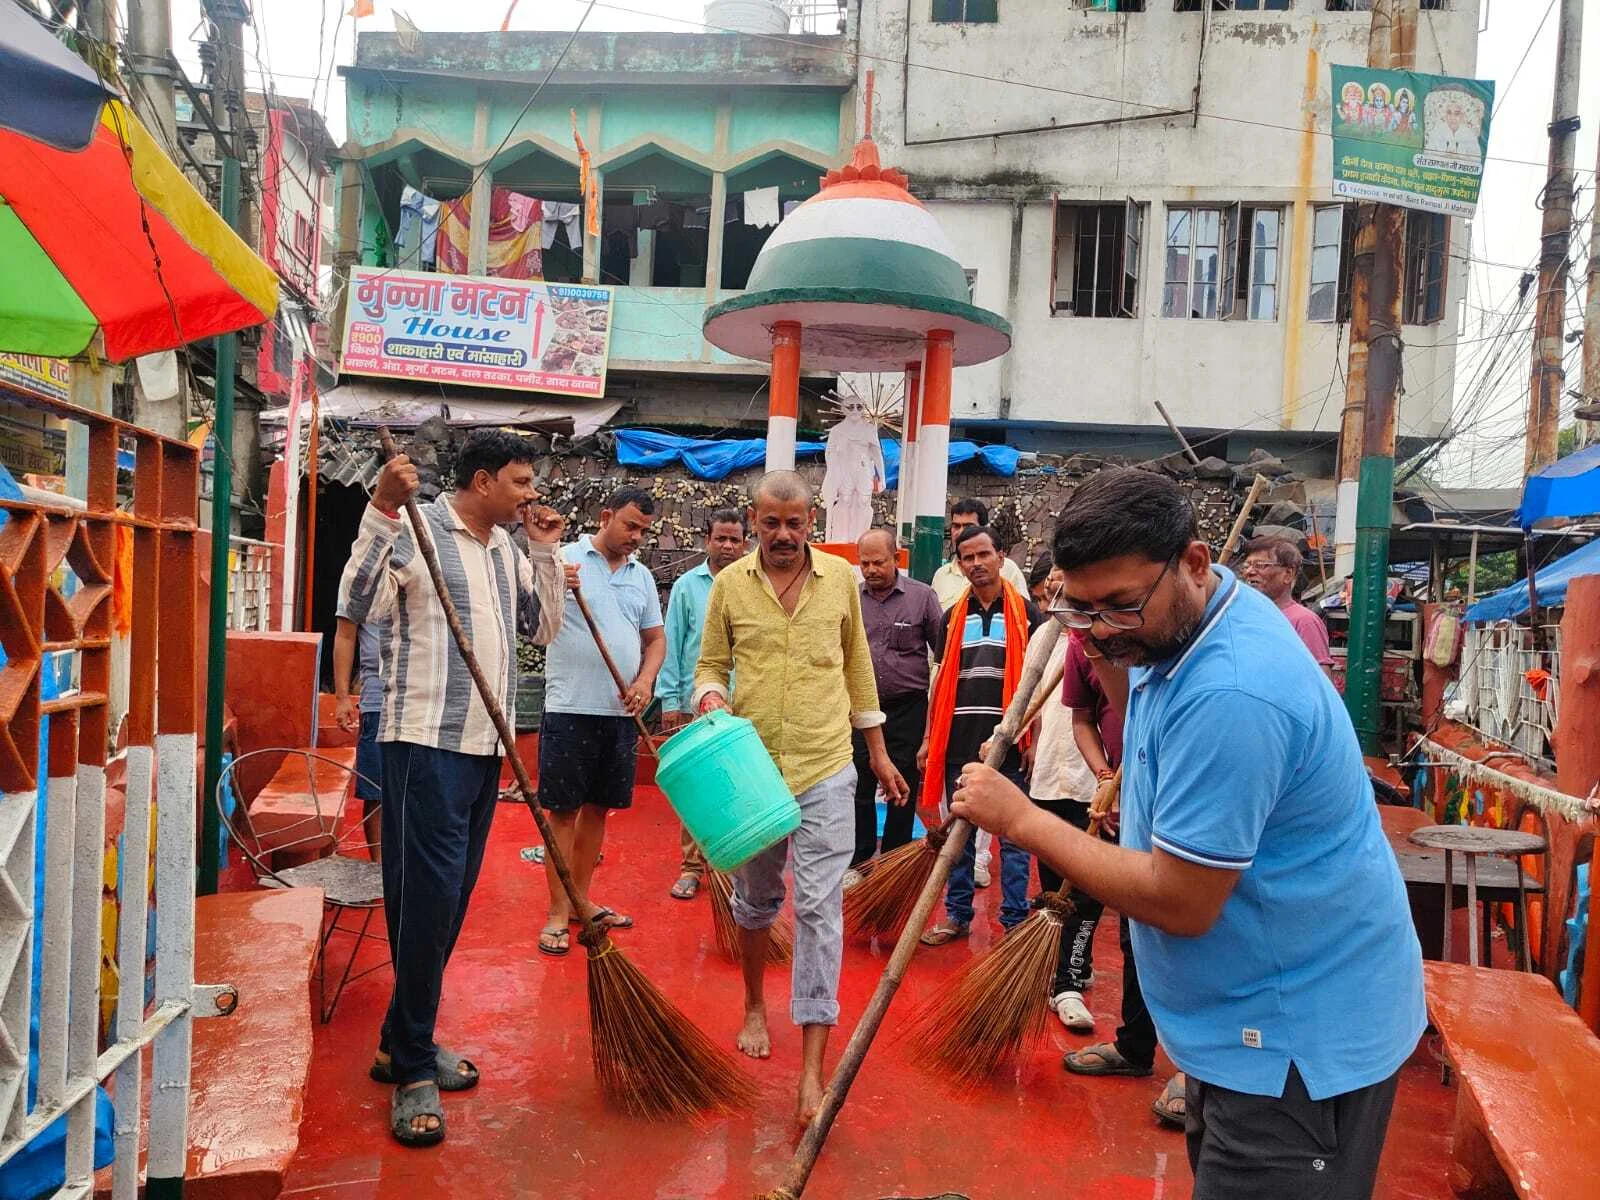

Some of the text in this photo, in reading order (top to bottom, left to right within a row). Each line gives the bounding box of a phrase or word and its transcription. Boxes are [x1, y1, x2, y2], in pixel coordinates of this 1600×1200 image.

[357, 273, 531, 321] मुन्ना मटन
[403, 316, 510, 343] House
[387, 343, 523, 367] शाकाहारी एवं मांसाहारी
